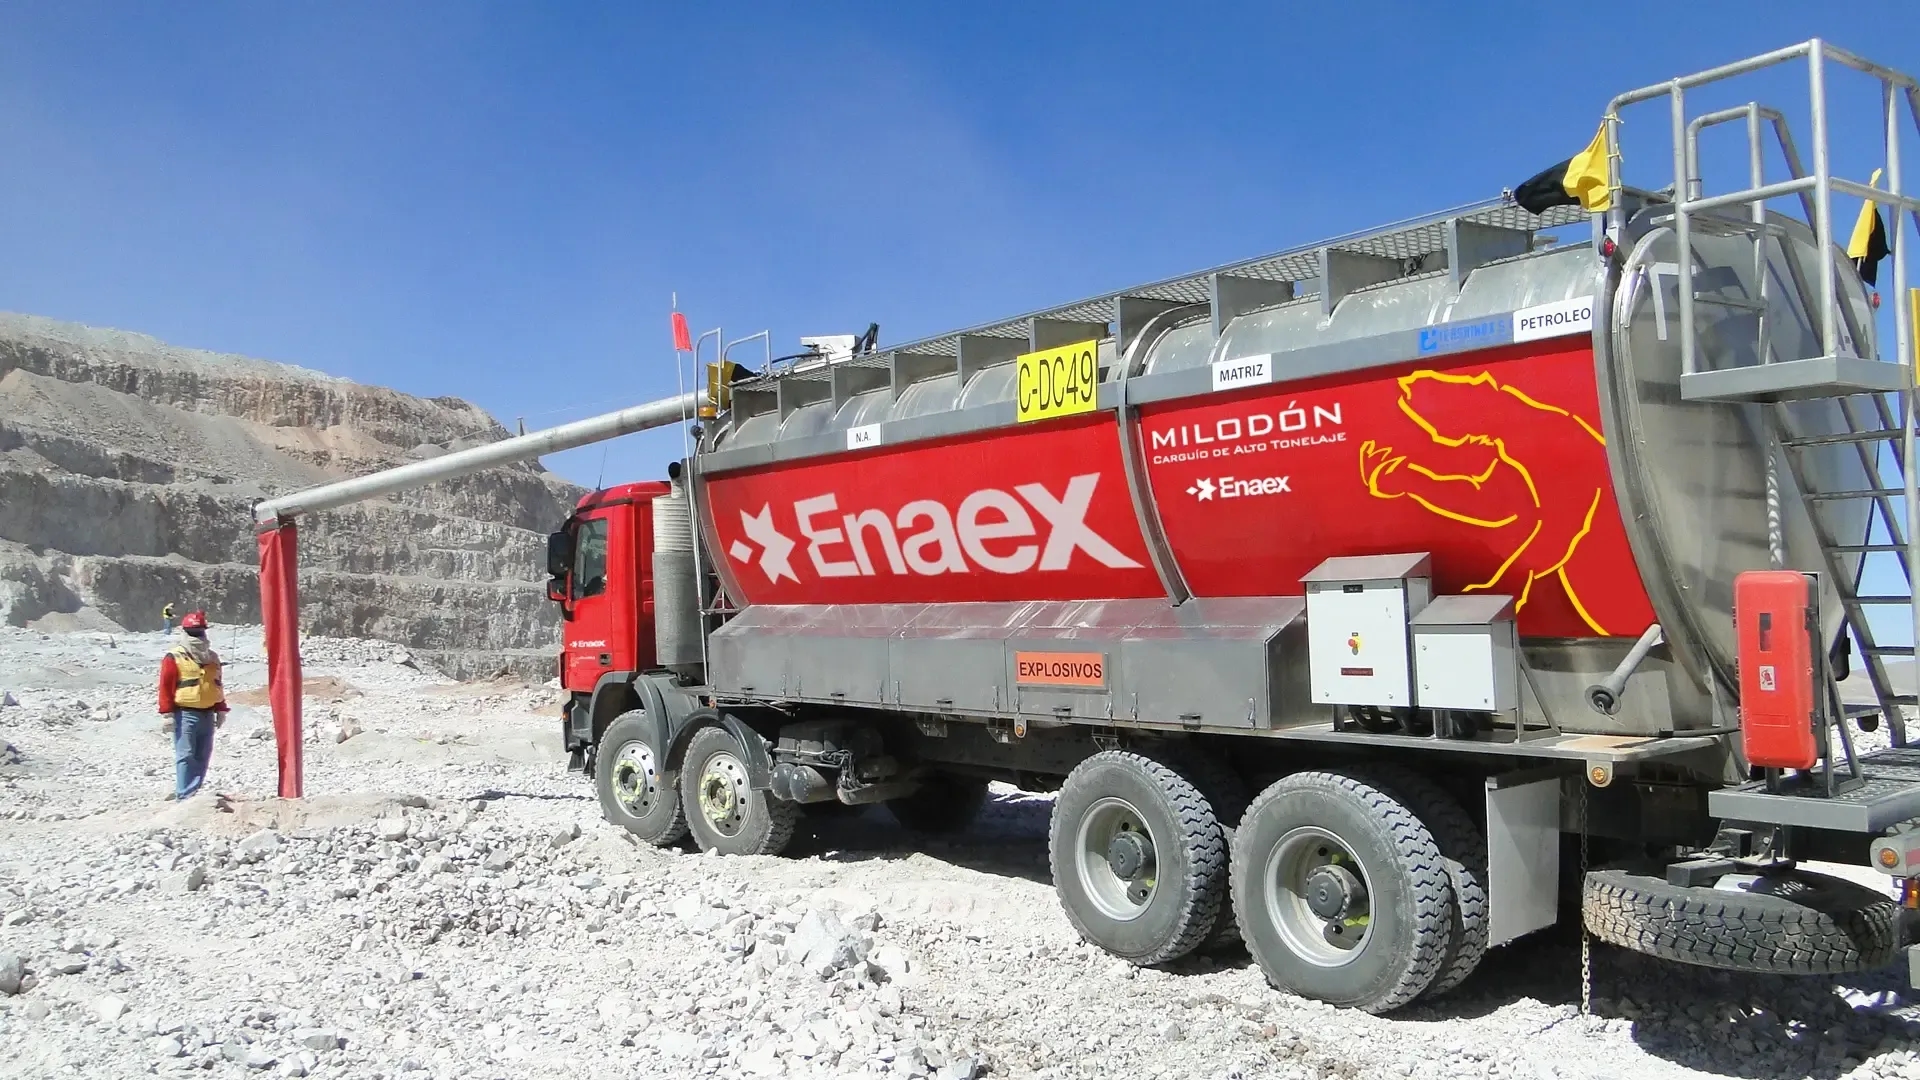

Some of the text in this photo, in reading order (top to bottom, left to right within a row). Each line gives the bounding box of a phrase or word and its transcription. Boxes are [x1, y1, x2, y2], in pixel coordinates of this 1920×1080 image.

[1520, 307, 1591, 331] PETROLEO
[1018, 350, 1094, 413] C-DC49
[1219, 363, 1264, 382] MATRIZ
[855, 430, 872, 443] N.A.
[1151, 400, 1343, 450] MILODÓN
[1153, 431, 1347, 465] CARGUÍO DE ALTO TONELAJE
[1219, 475, 1292, 498] Enaex
[793, 472, 1147, 578] Enaex
[1019, 662, 1102, 679] EXPLOSIVOS
